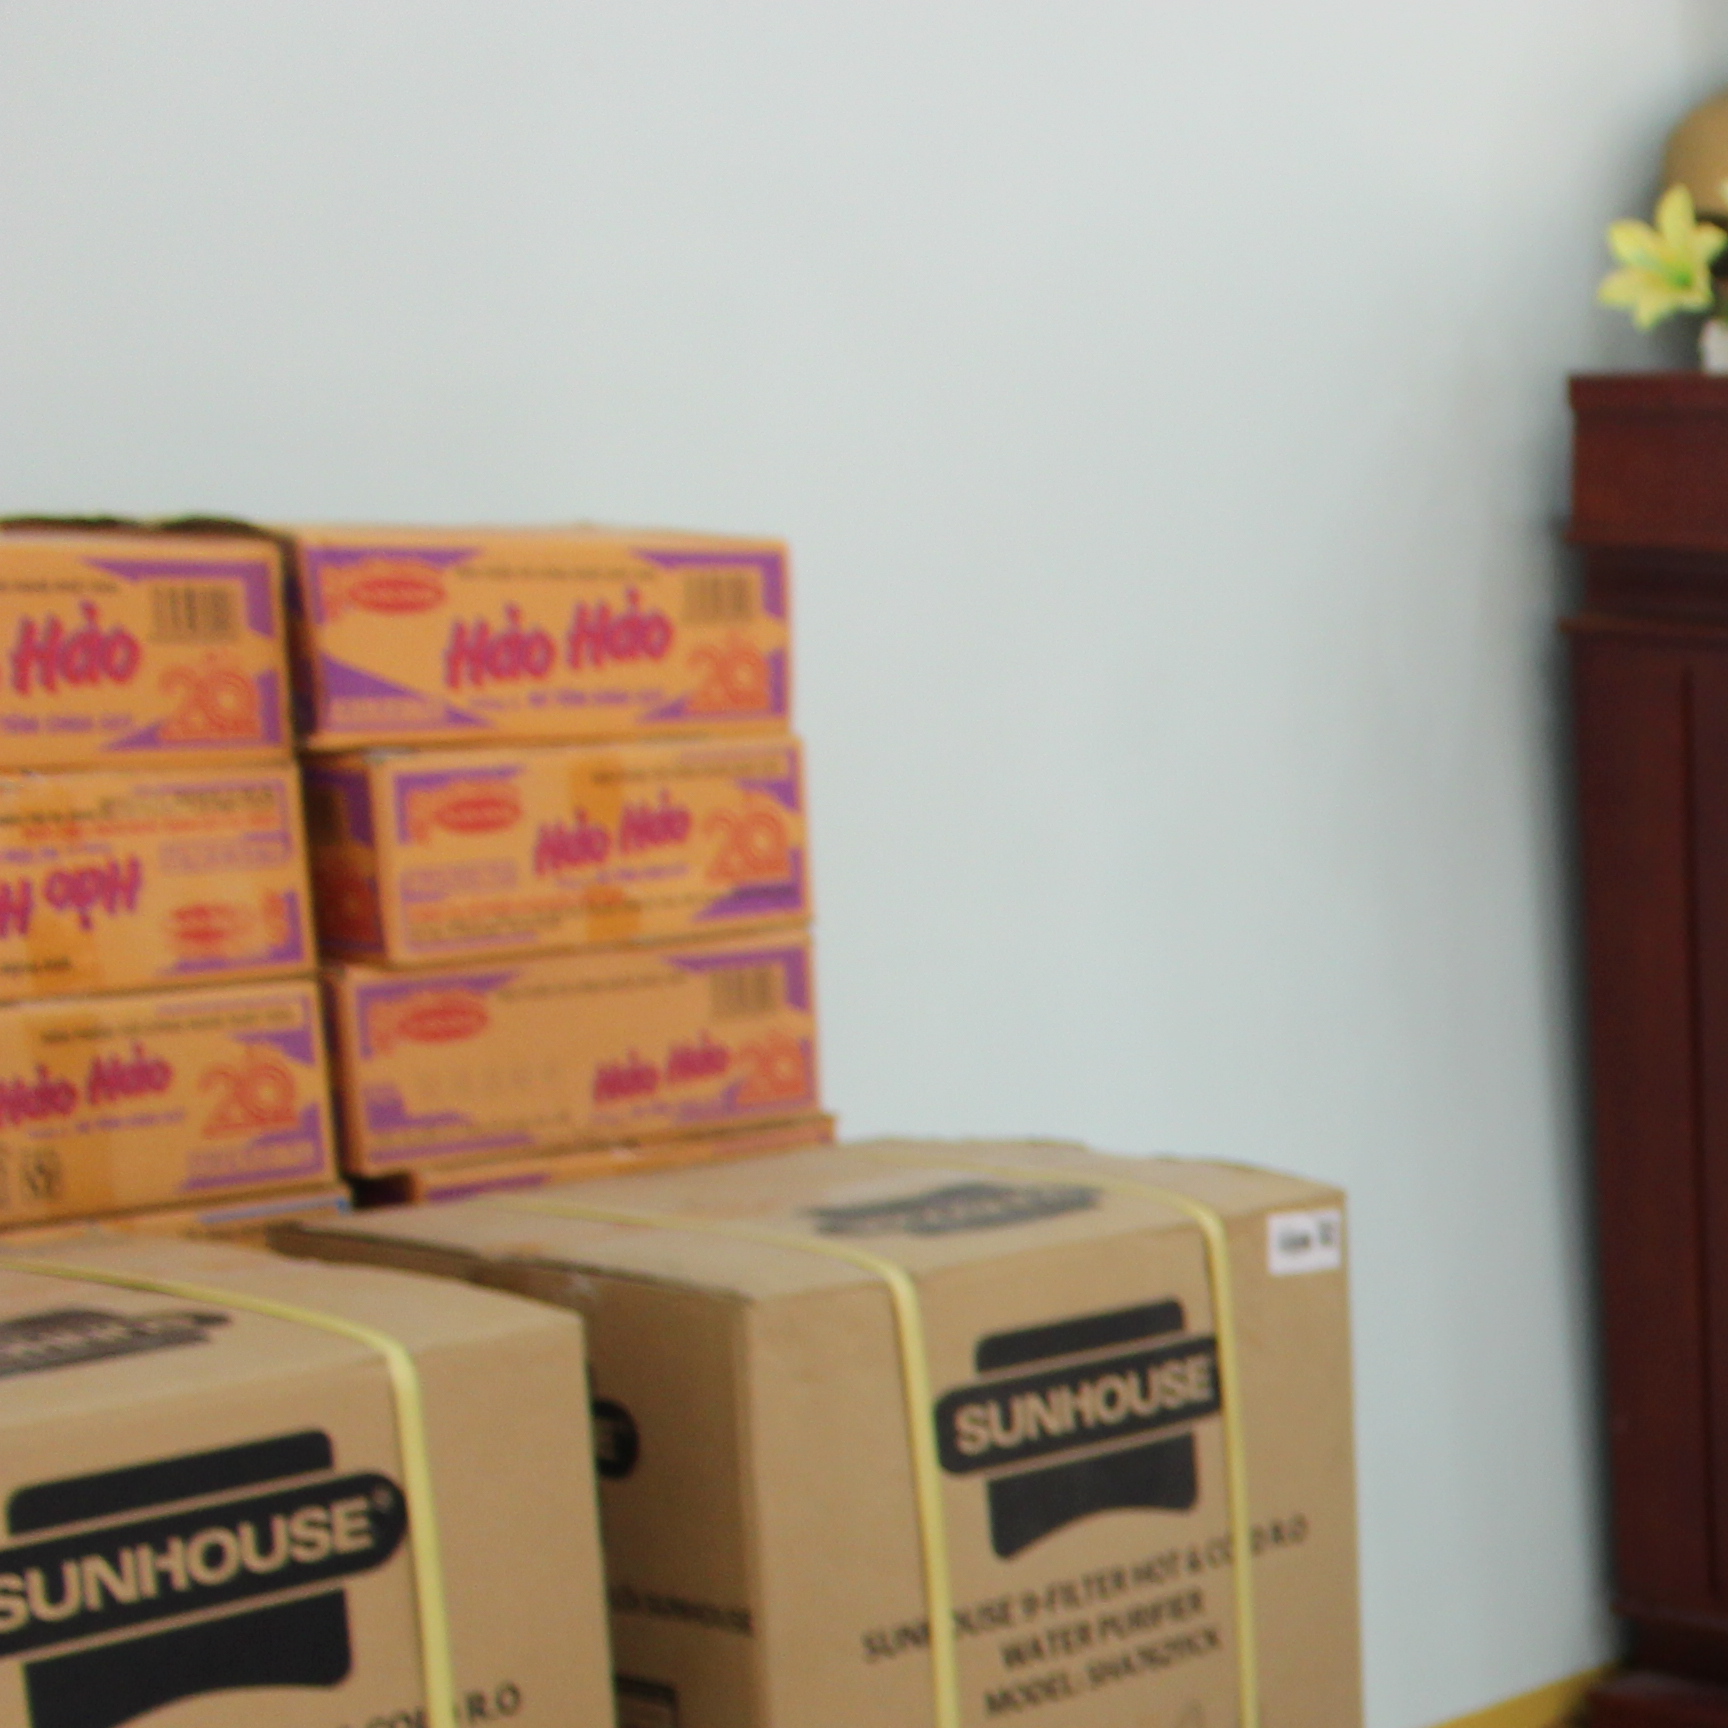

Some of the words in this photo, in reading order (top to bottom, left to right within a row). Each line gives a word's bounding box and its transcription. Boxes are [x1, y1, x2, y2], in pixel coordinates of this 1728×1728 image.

[953, 1352, 1213, 1456] SUNHOUSE
[1132, 1549, 1180, 1586] HOT
[1002, 1617, 1093, 1671] WATER
[1098, 1586, 1204, 1642] PURIFIER
